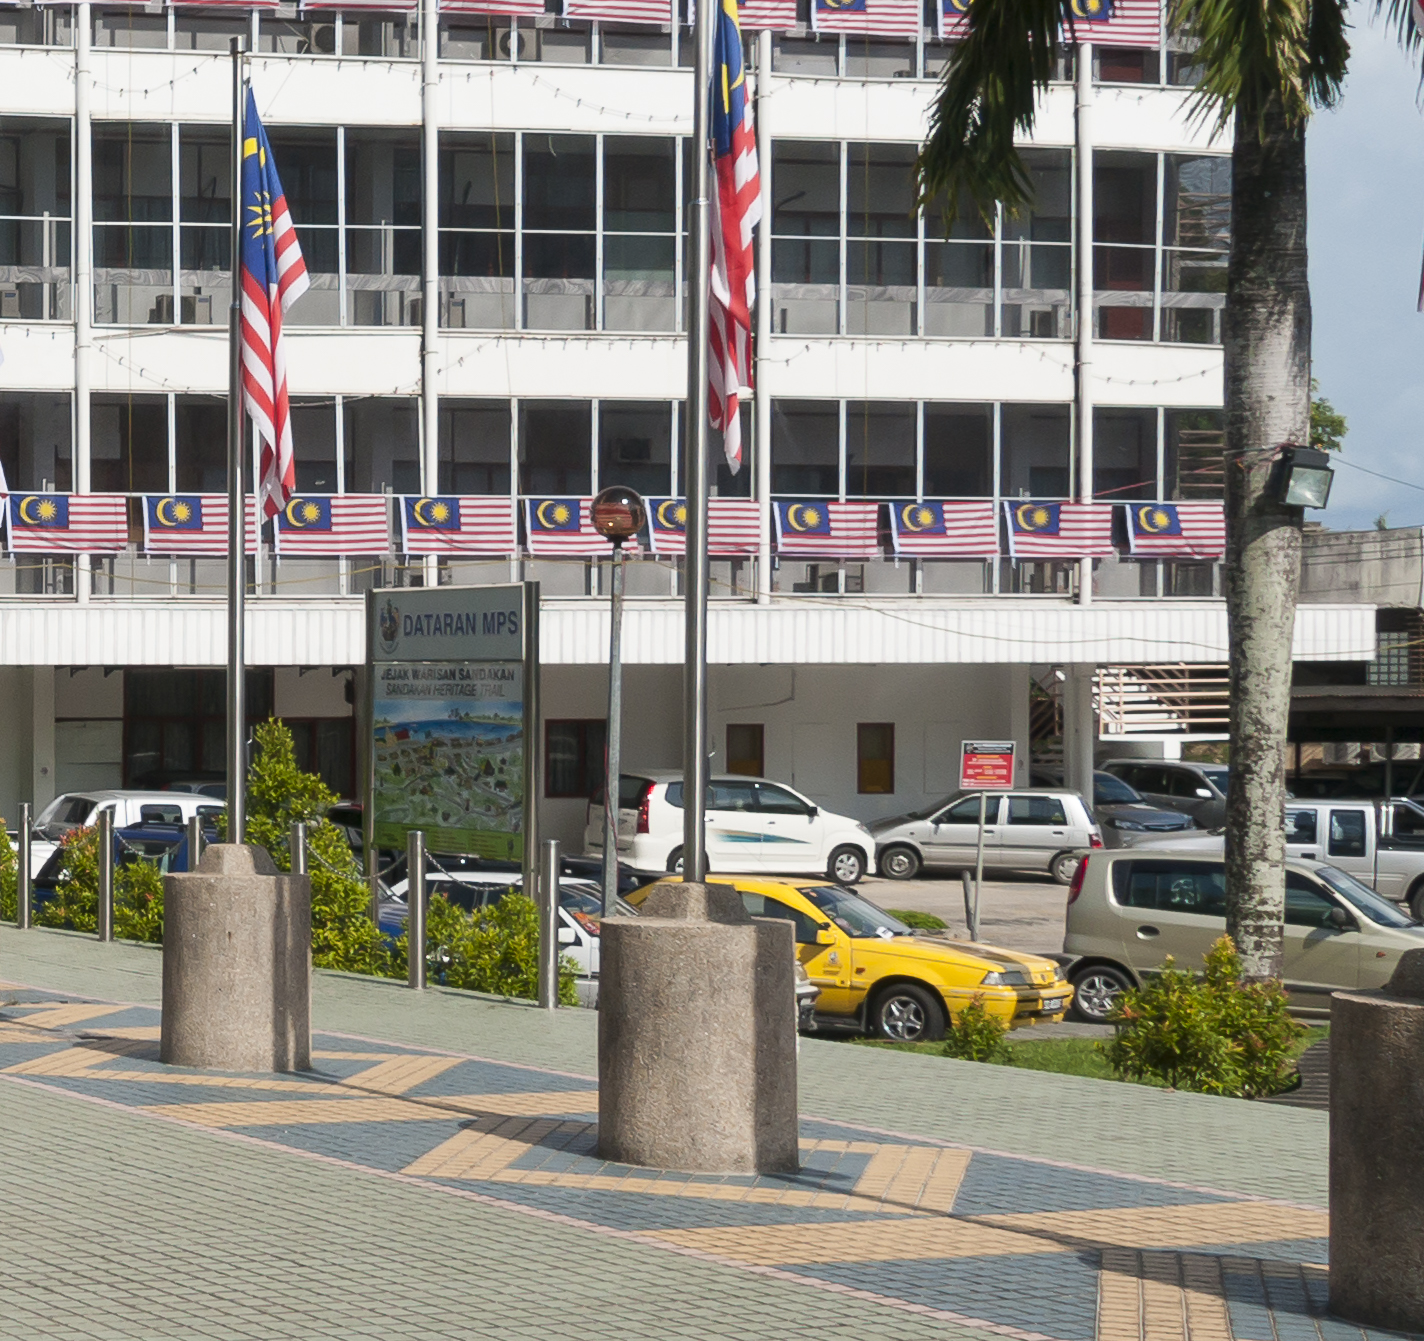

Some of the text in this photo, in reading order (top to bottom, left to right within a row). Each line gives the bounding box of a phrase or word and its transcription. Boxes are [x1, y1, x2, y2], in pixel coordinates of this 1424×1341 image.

[403, 610, 519, 637] DATARAN MPS
[381, 667, 515, 681] JEJAK WARISAN SANDAKAN
[386, 682, 431, 696] SANDAKAN
[433, 682, 477, 697] HERITAGE
